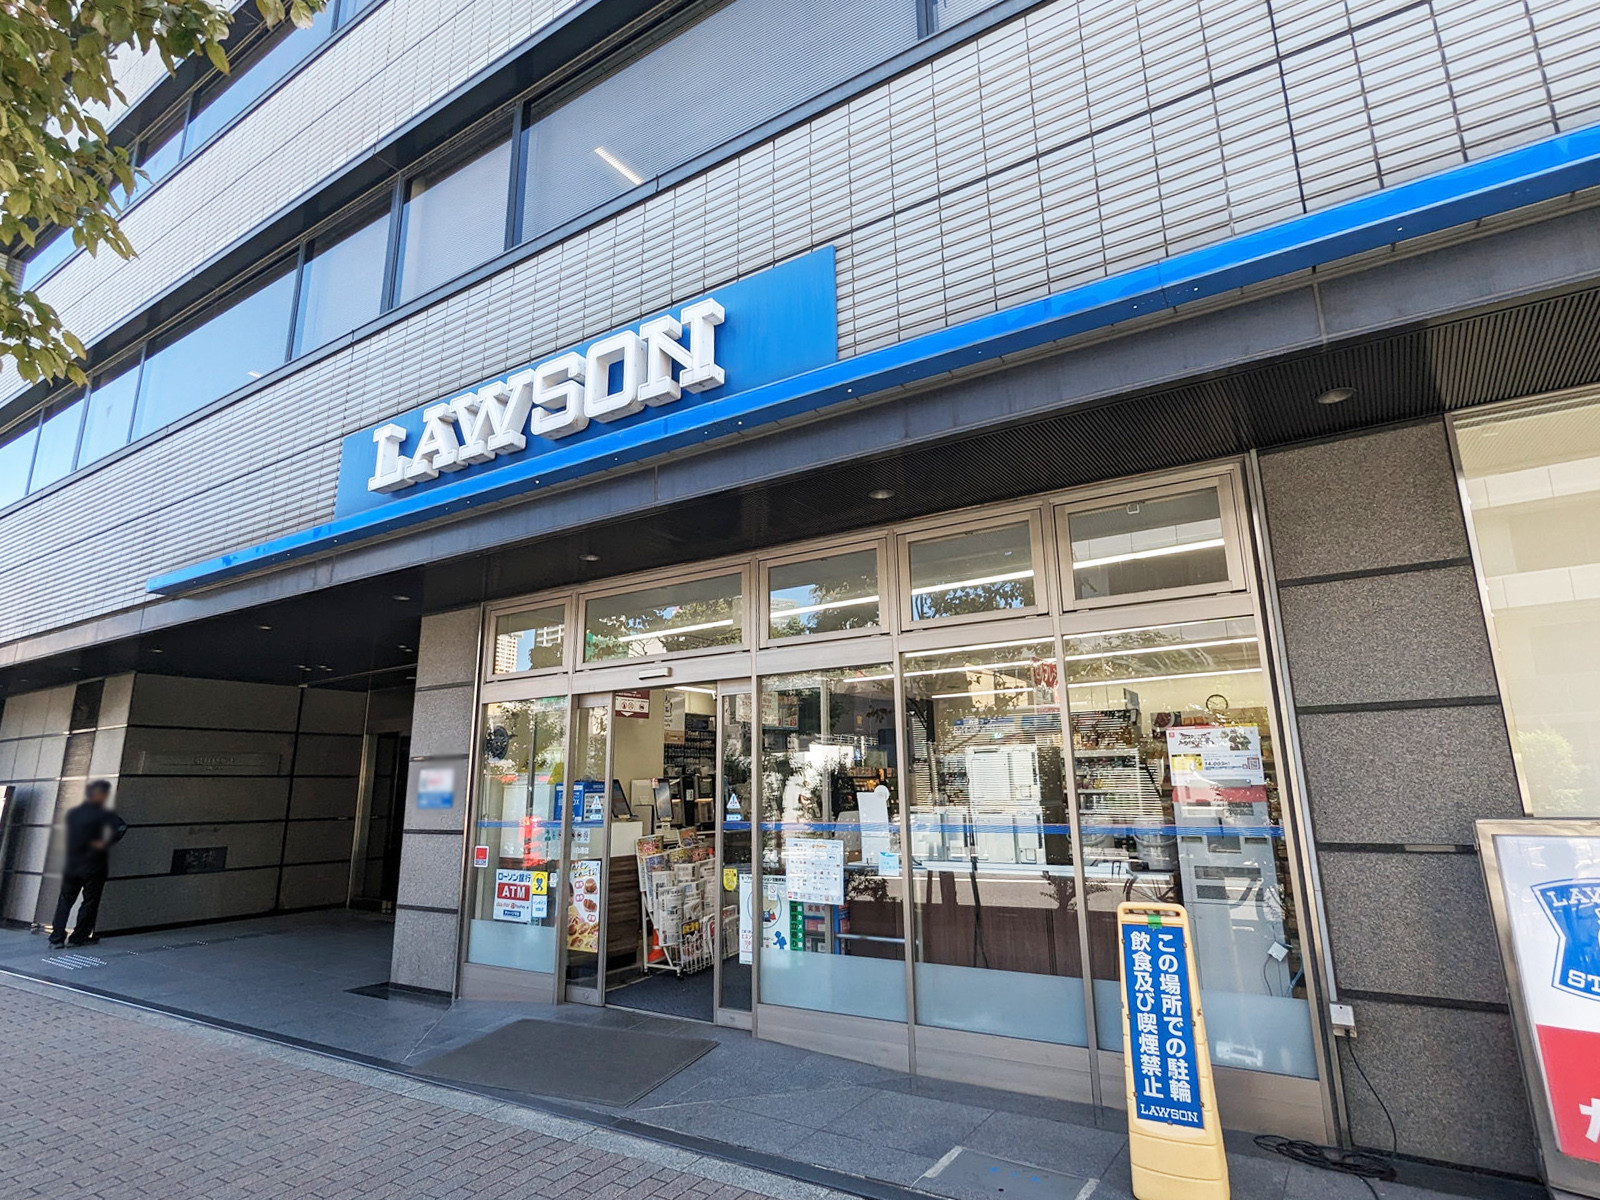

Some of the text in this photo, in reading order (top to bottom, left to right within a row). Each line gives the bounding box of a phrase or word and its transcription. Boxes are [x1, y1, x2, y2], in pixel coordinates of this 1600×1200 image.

[368, 298, 726, 492] LAWSON
[498, 872, 531, 883] ローソン銀行
[502, 886, 526, 899] ATM
[1130, 930, 1164, 1100] 飲食及び喫煙禁止
[1158, 934, 1192, 1104] この場所での駐輪
[1140, 1103, 1199, 1123] LAWSON
